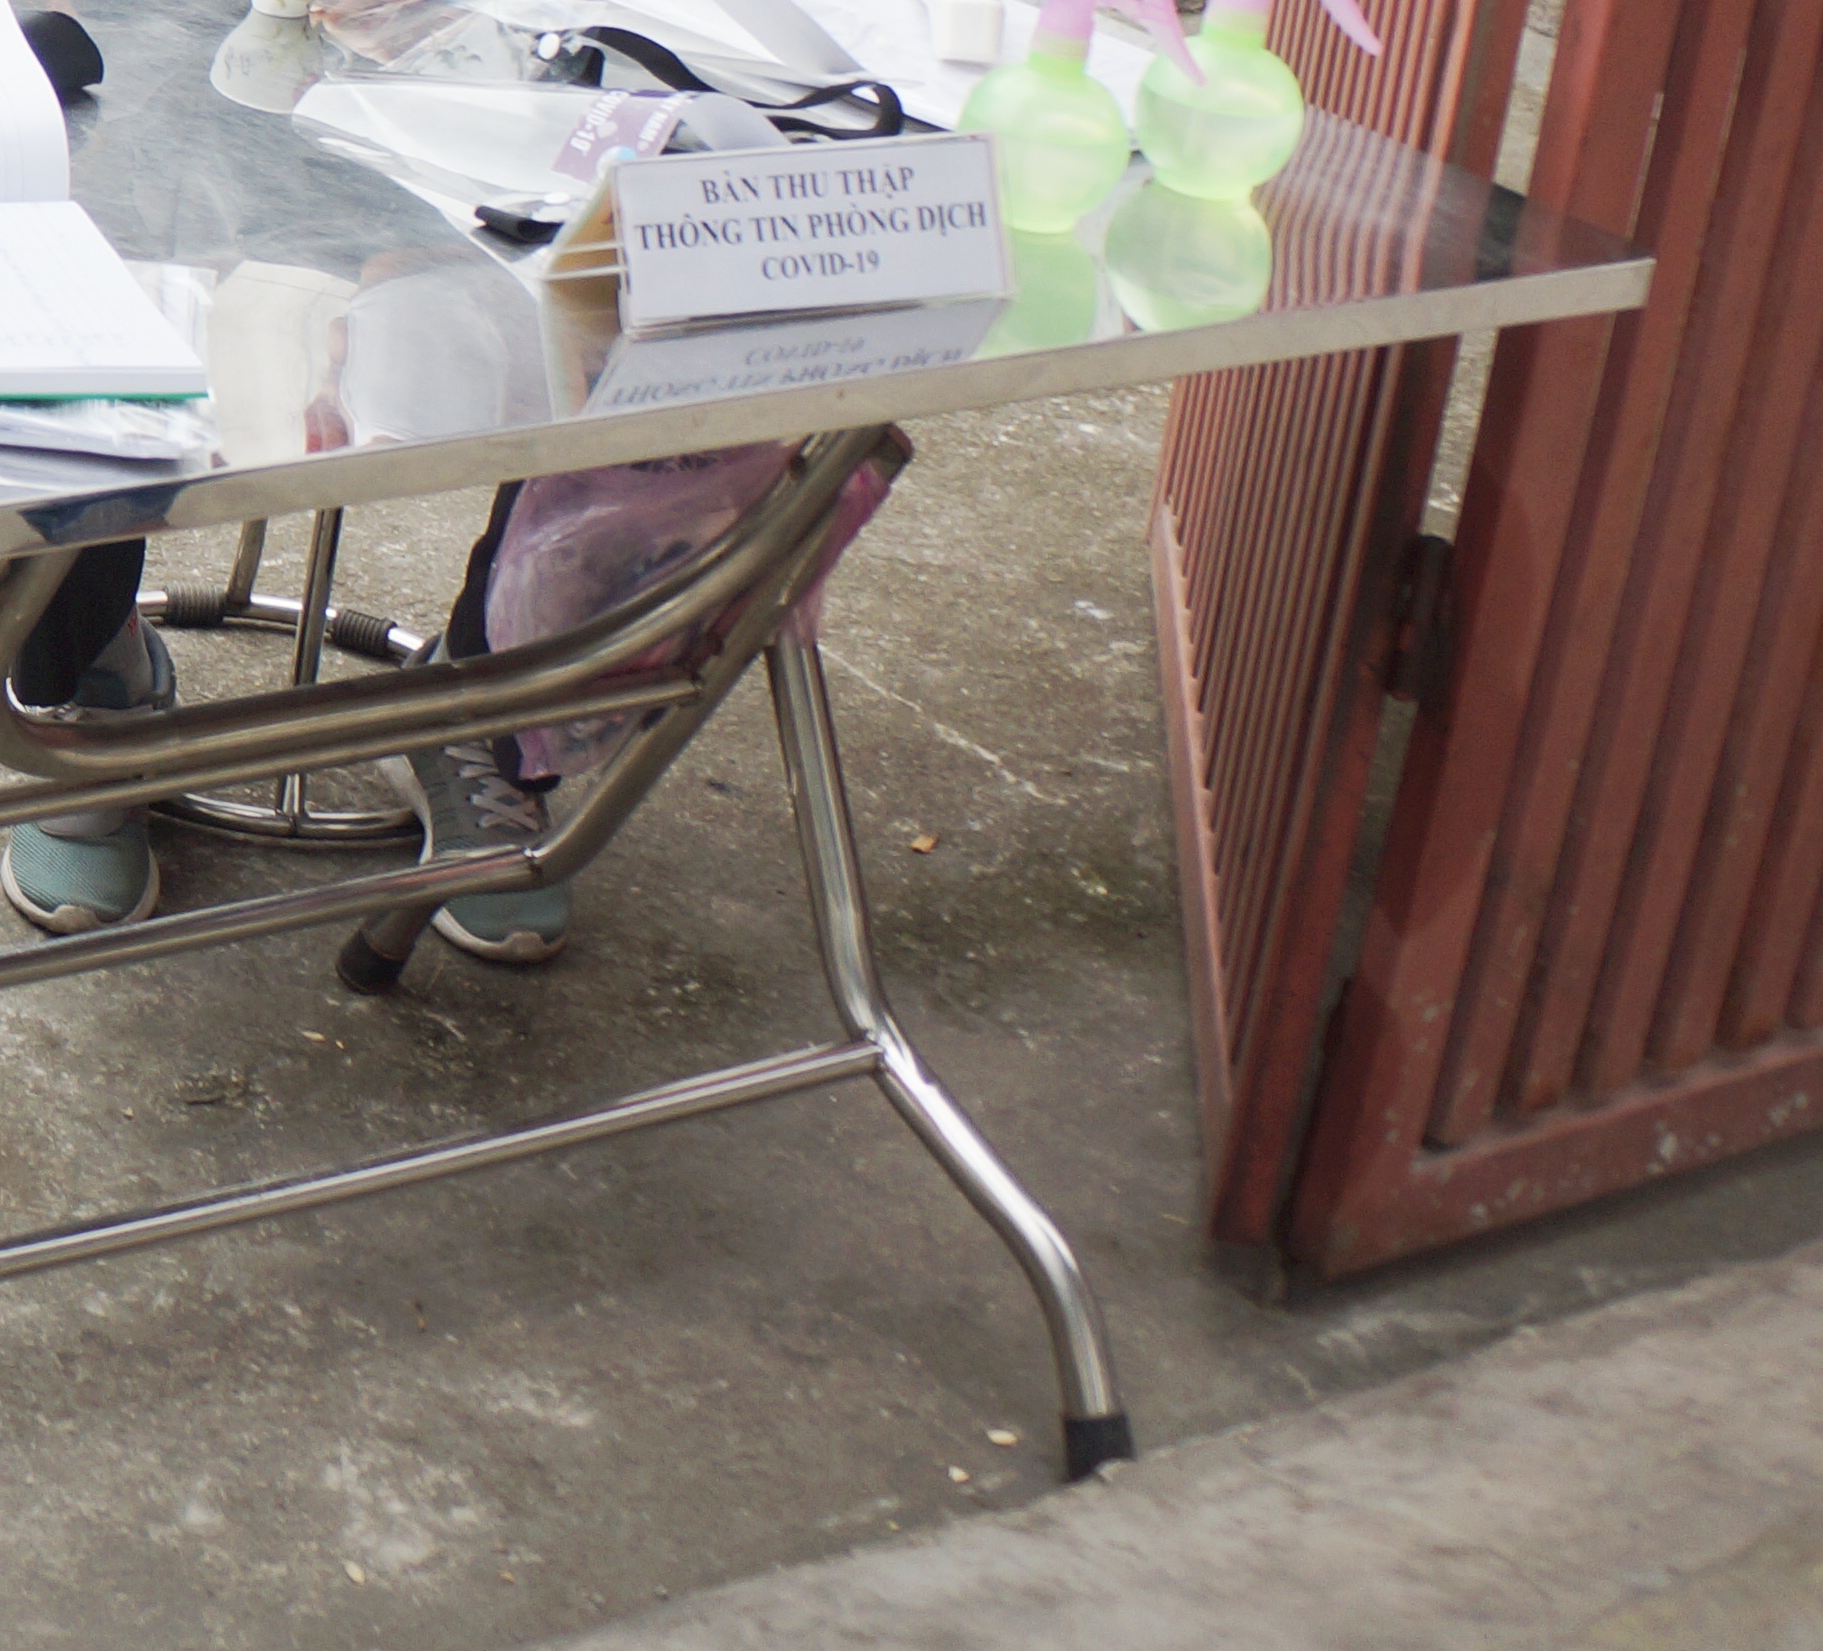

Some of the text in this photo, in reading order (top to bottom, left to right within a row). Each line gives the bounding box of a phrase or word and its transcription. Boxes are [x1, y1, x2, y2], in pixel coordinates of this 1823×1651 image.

[700, 164, 915, 205] BÀN THU THẬP
[634, 200, 988, 251] THÔNG TIN PHÒNG DỊCH
[761, 249, 881, 281] COVID-19
